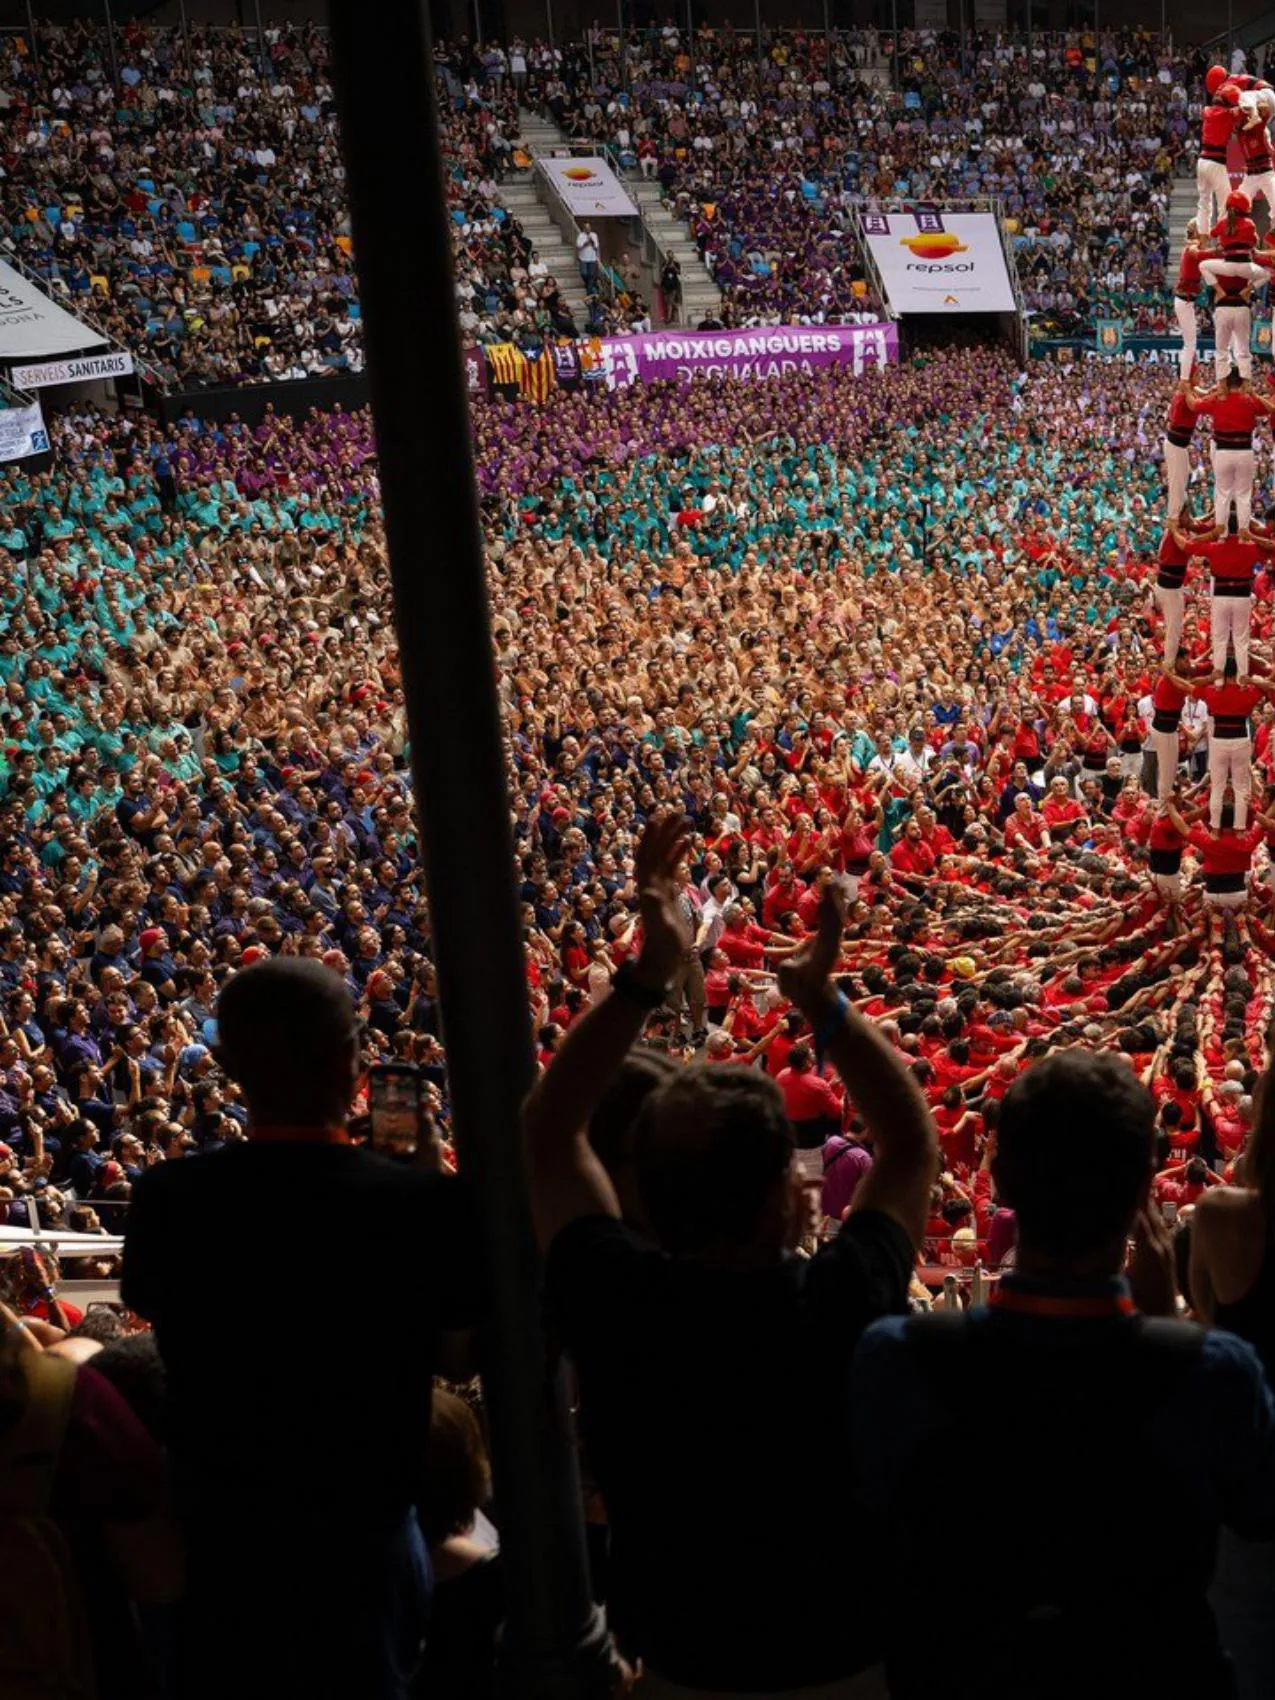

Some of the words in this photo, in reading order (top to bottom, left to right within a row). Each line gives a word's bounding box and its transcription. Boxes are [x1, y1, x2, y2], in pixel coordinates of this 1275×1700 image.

[907, 262, 974, 273] repsol
[644, 334, 841, 361] MOIXIGANGUERS
[67, 357, 125, 378] SANITARIS
